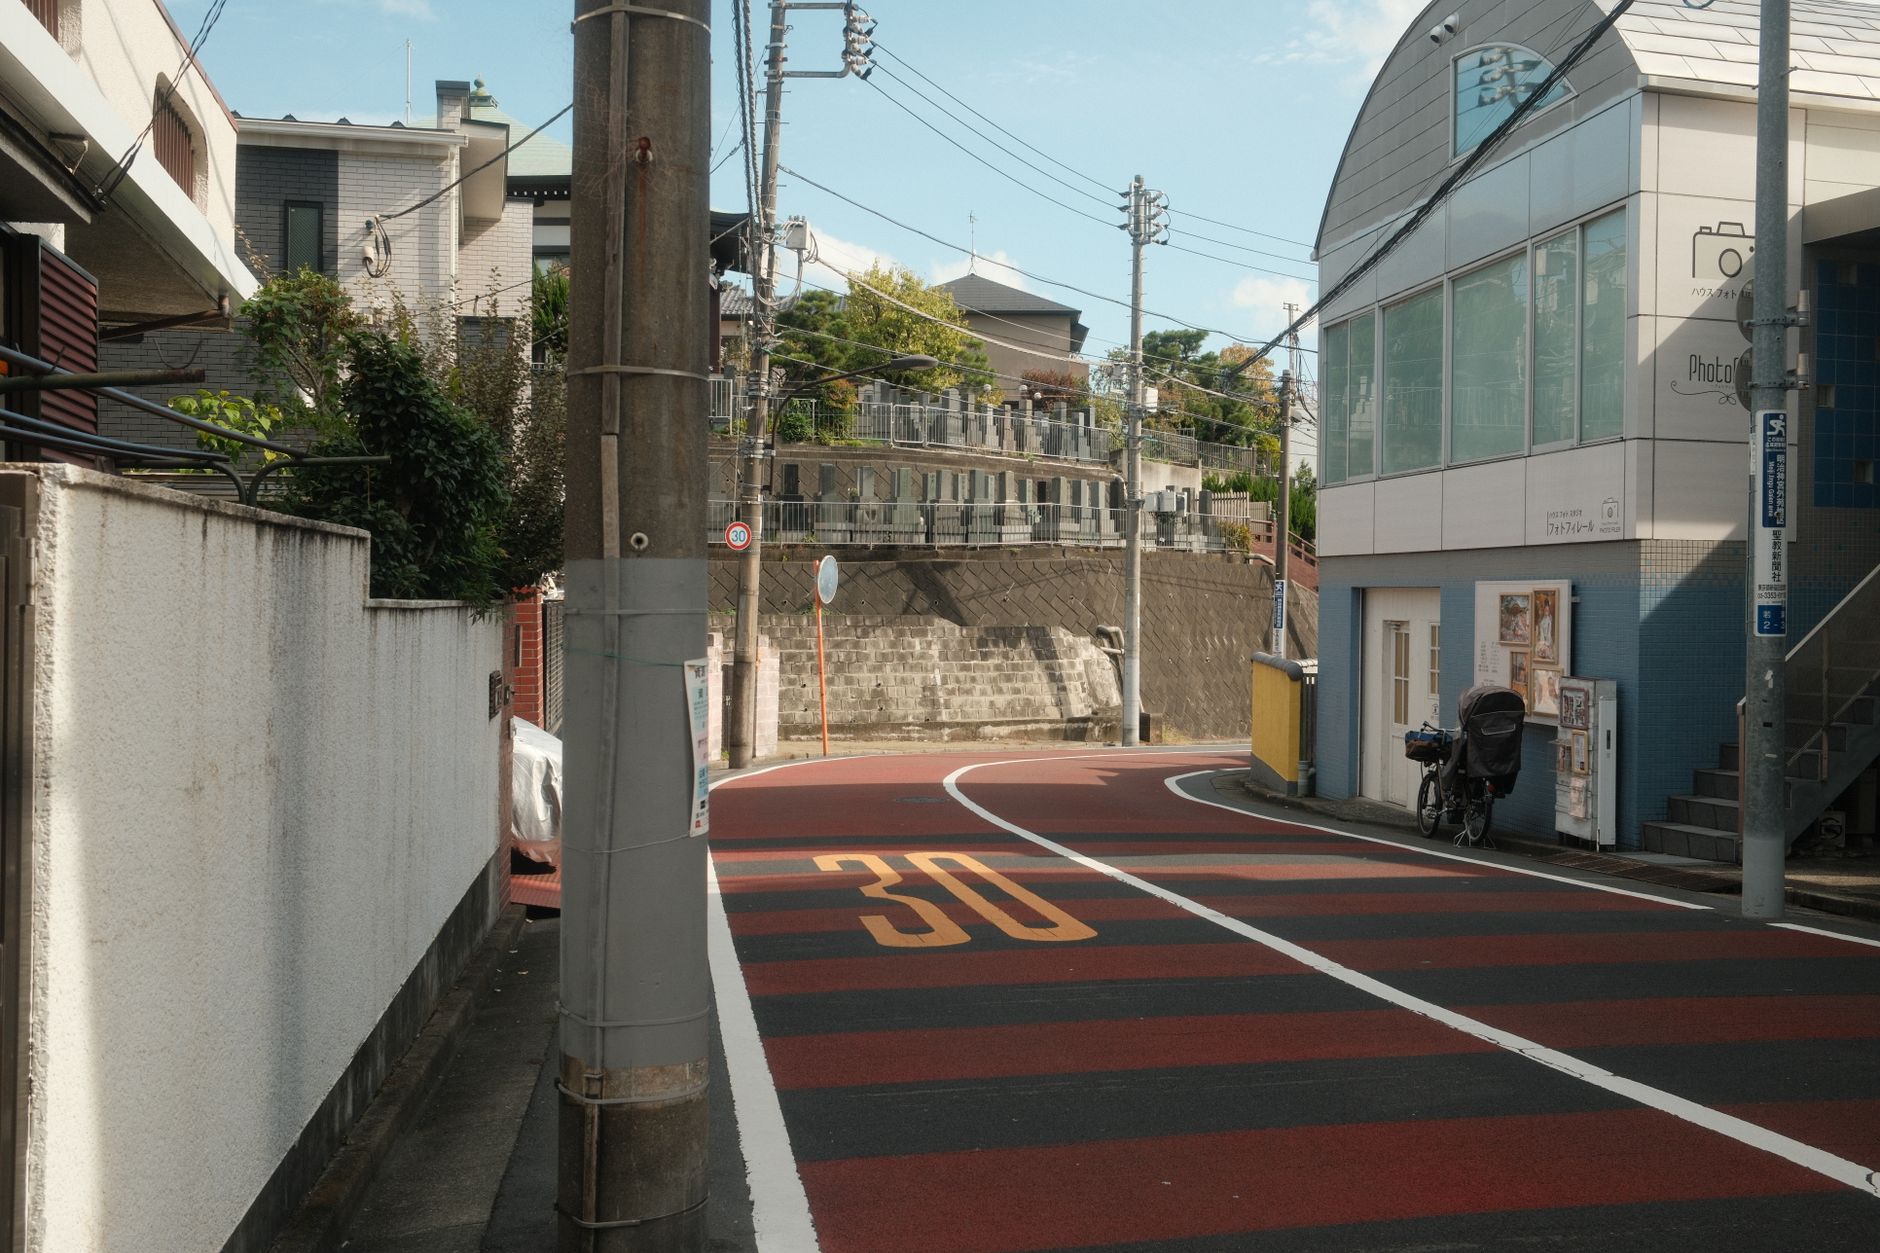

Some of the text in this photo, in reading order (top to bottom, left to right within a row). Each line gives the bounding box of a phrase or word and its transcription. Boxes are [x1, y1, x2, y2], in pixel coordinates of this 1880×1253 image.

[1691, 287, 1737, 299] ハウス フォト
[731, 530, 746, 542] 30
[1549, 520, 1595, 536] フォトフィレール
[1772, 530, 1782, 582] 聖教新聞社
[812, 852, 1098, 948] 30
